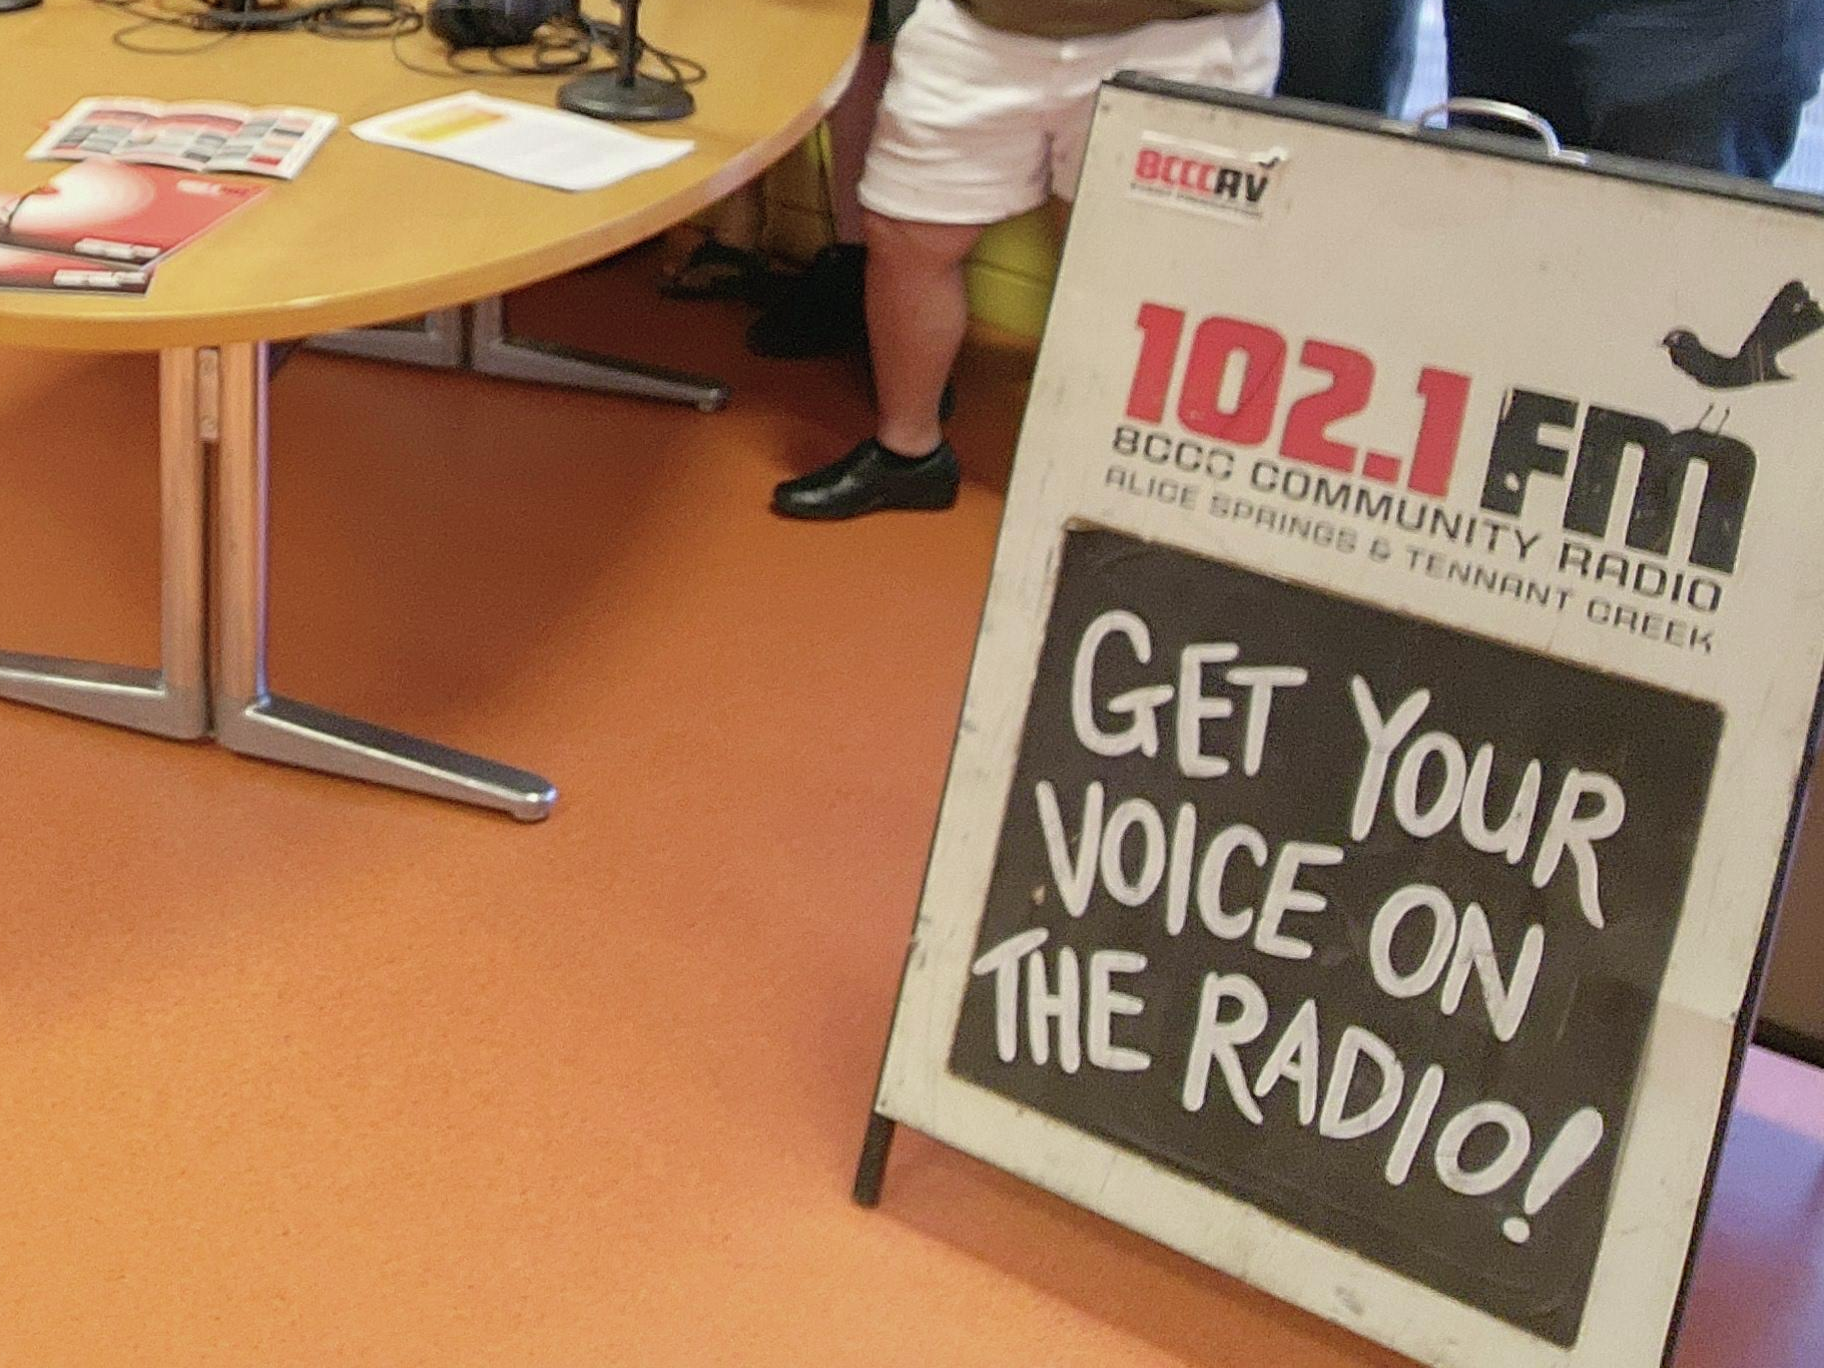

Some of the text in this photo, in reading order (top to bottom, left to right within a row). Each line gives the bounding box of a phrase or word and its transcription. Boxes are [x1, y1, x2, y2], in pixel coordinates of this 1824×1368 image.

[1104, 464, 1716, 656] ALICE SPRINGS & TENNANT CREEK
[1111, 425, 1723, 614] 8CCC COMMUNITY RADIO
[1126, 301, 1758, 576] 102.1 FM
[1072, 610, 1626, 929] GET YOUR
[1034, 780, 1545, 1042] VOICE ON
[973, 927, 1604, 1244] THE RADIO!
